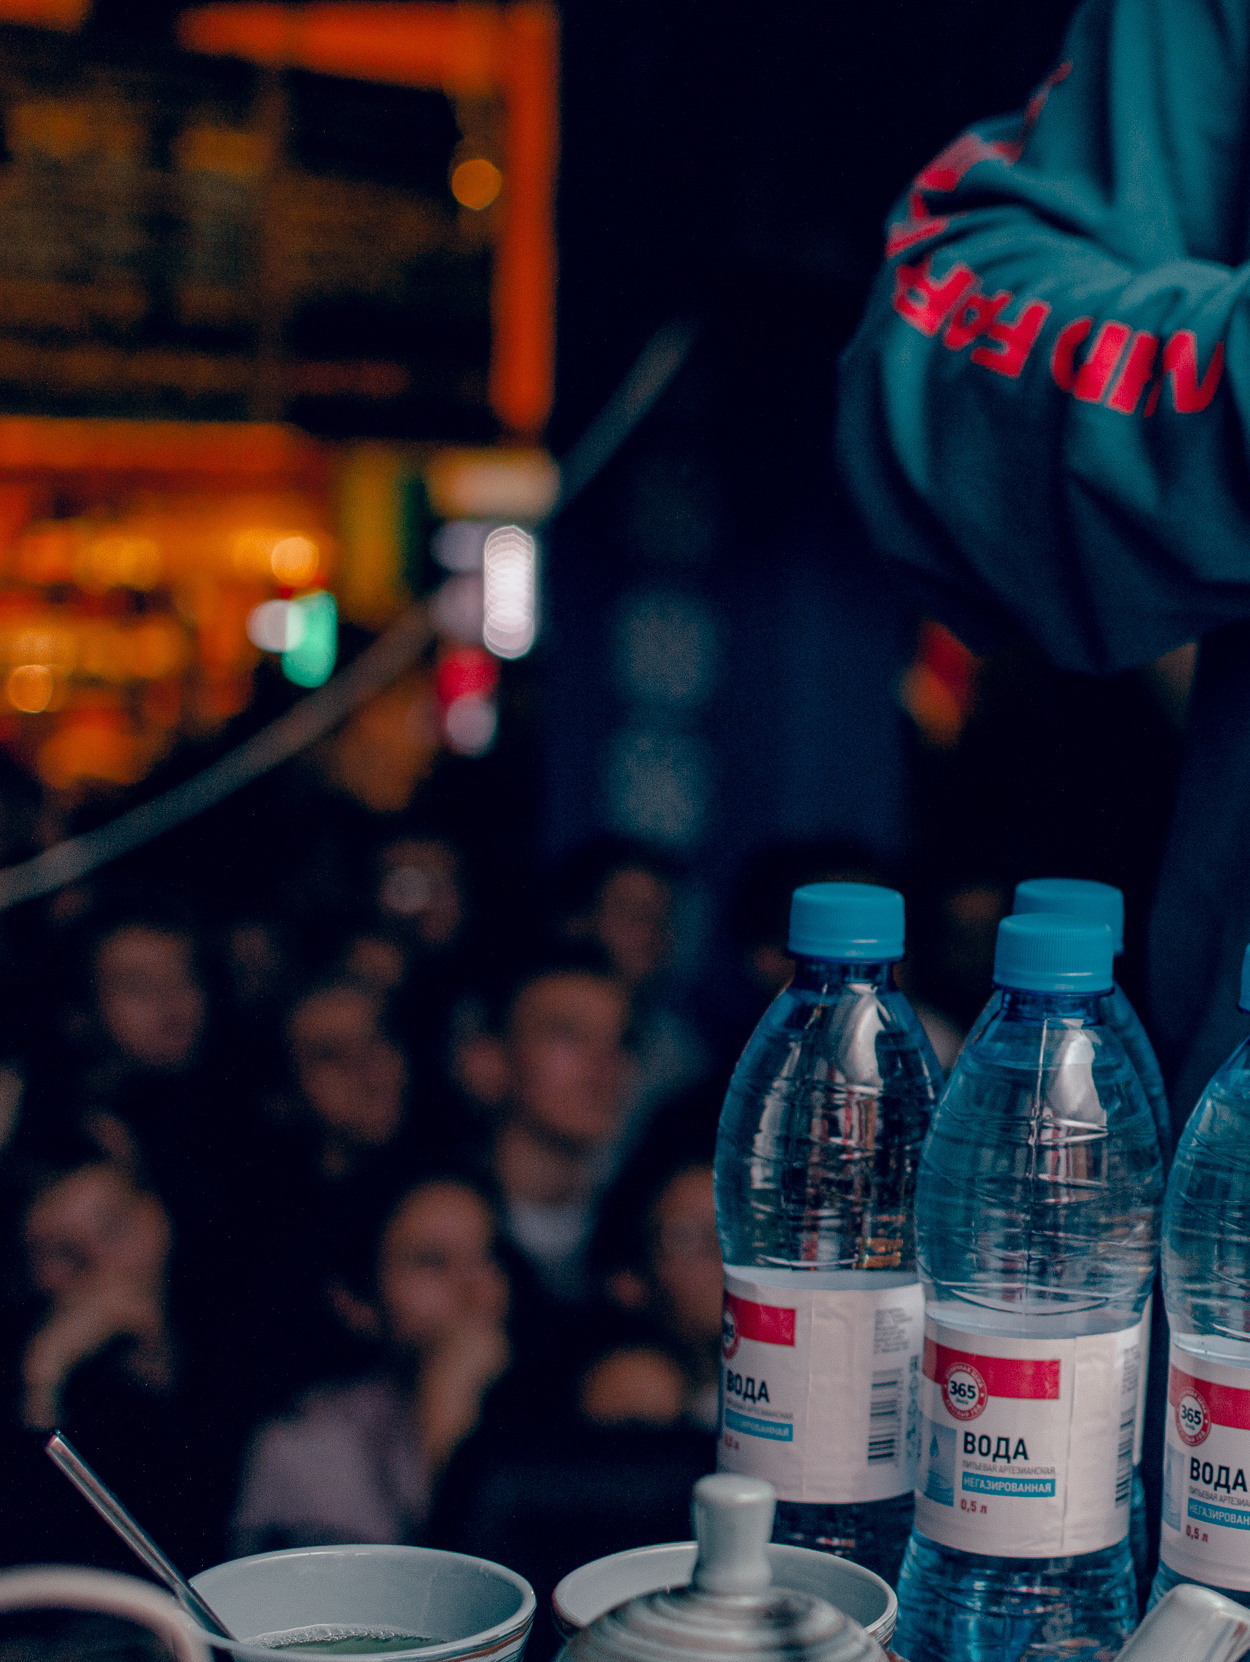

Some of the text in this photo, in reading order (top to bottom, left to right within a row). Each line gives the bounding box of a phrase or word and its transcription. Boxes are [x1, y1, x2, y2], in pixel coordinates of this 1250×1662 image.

[726, 1369, 770, 1405] ВОДА
[949, 1380, 976, 1400] 365
[1180, 1404, 1202, 1426] 365
[963, 1430, 1029, 1464] ВОДА
[963, 1476, 1052, 1493] НЕГАЗИРОВАННАЯ
[1190, 1456, 1248, 1494] ВОДА
[960, 1498, 988, 1514] 0,5 л
